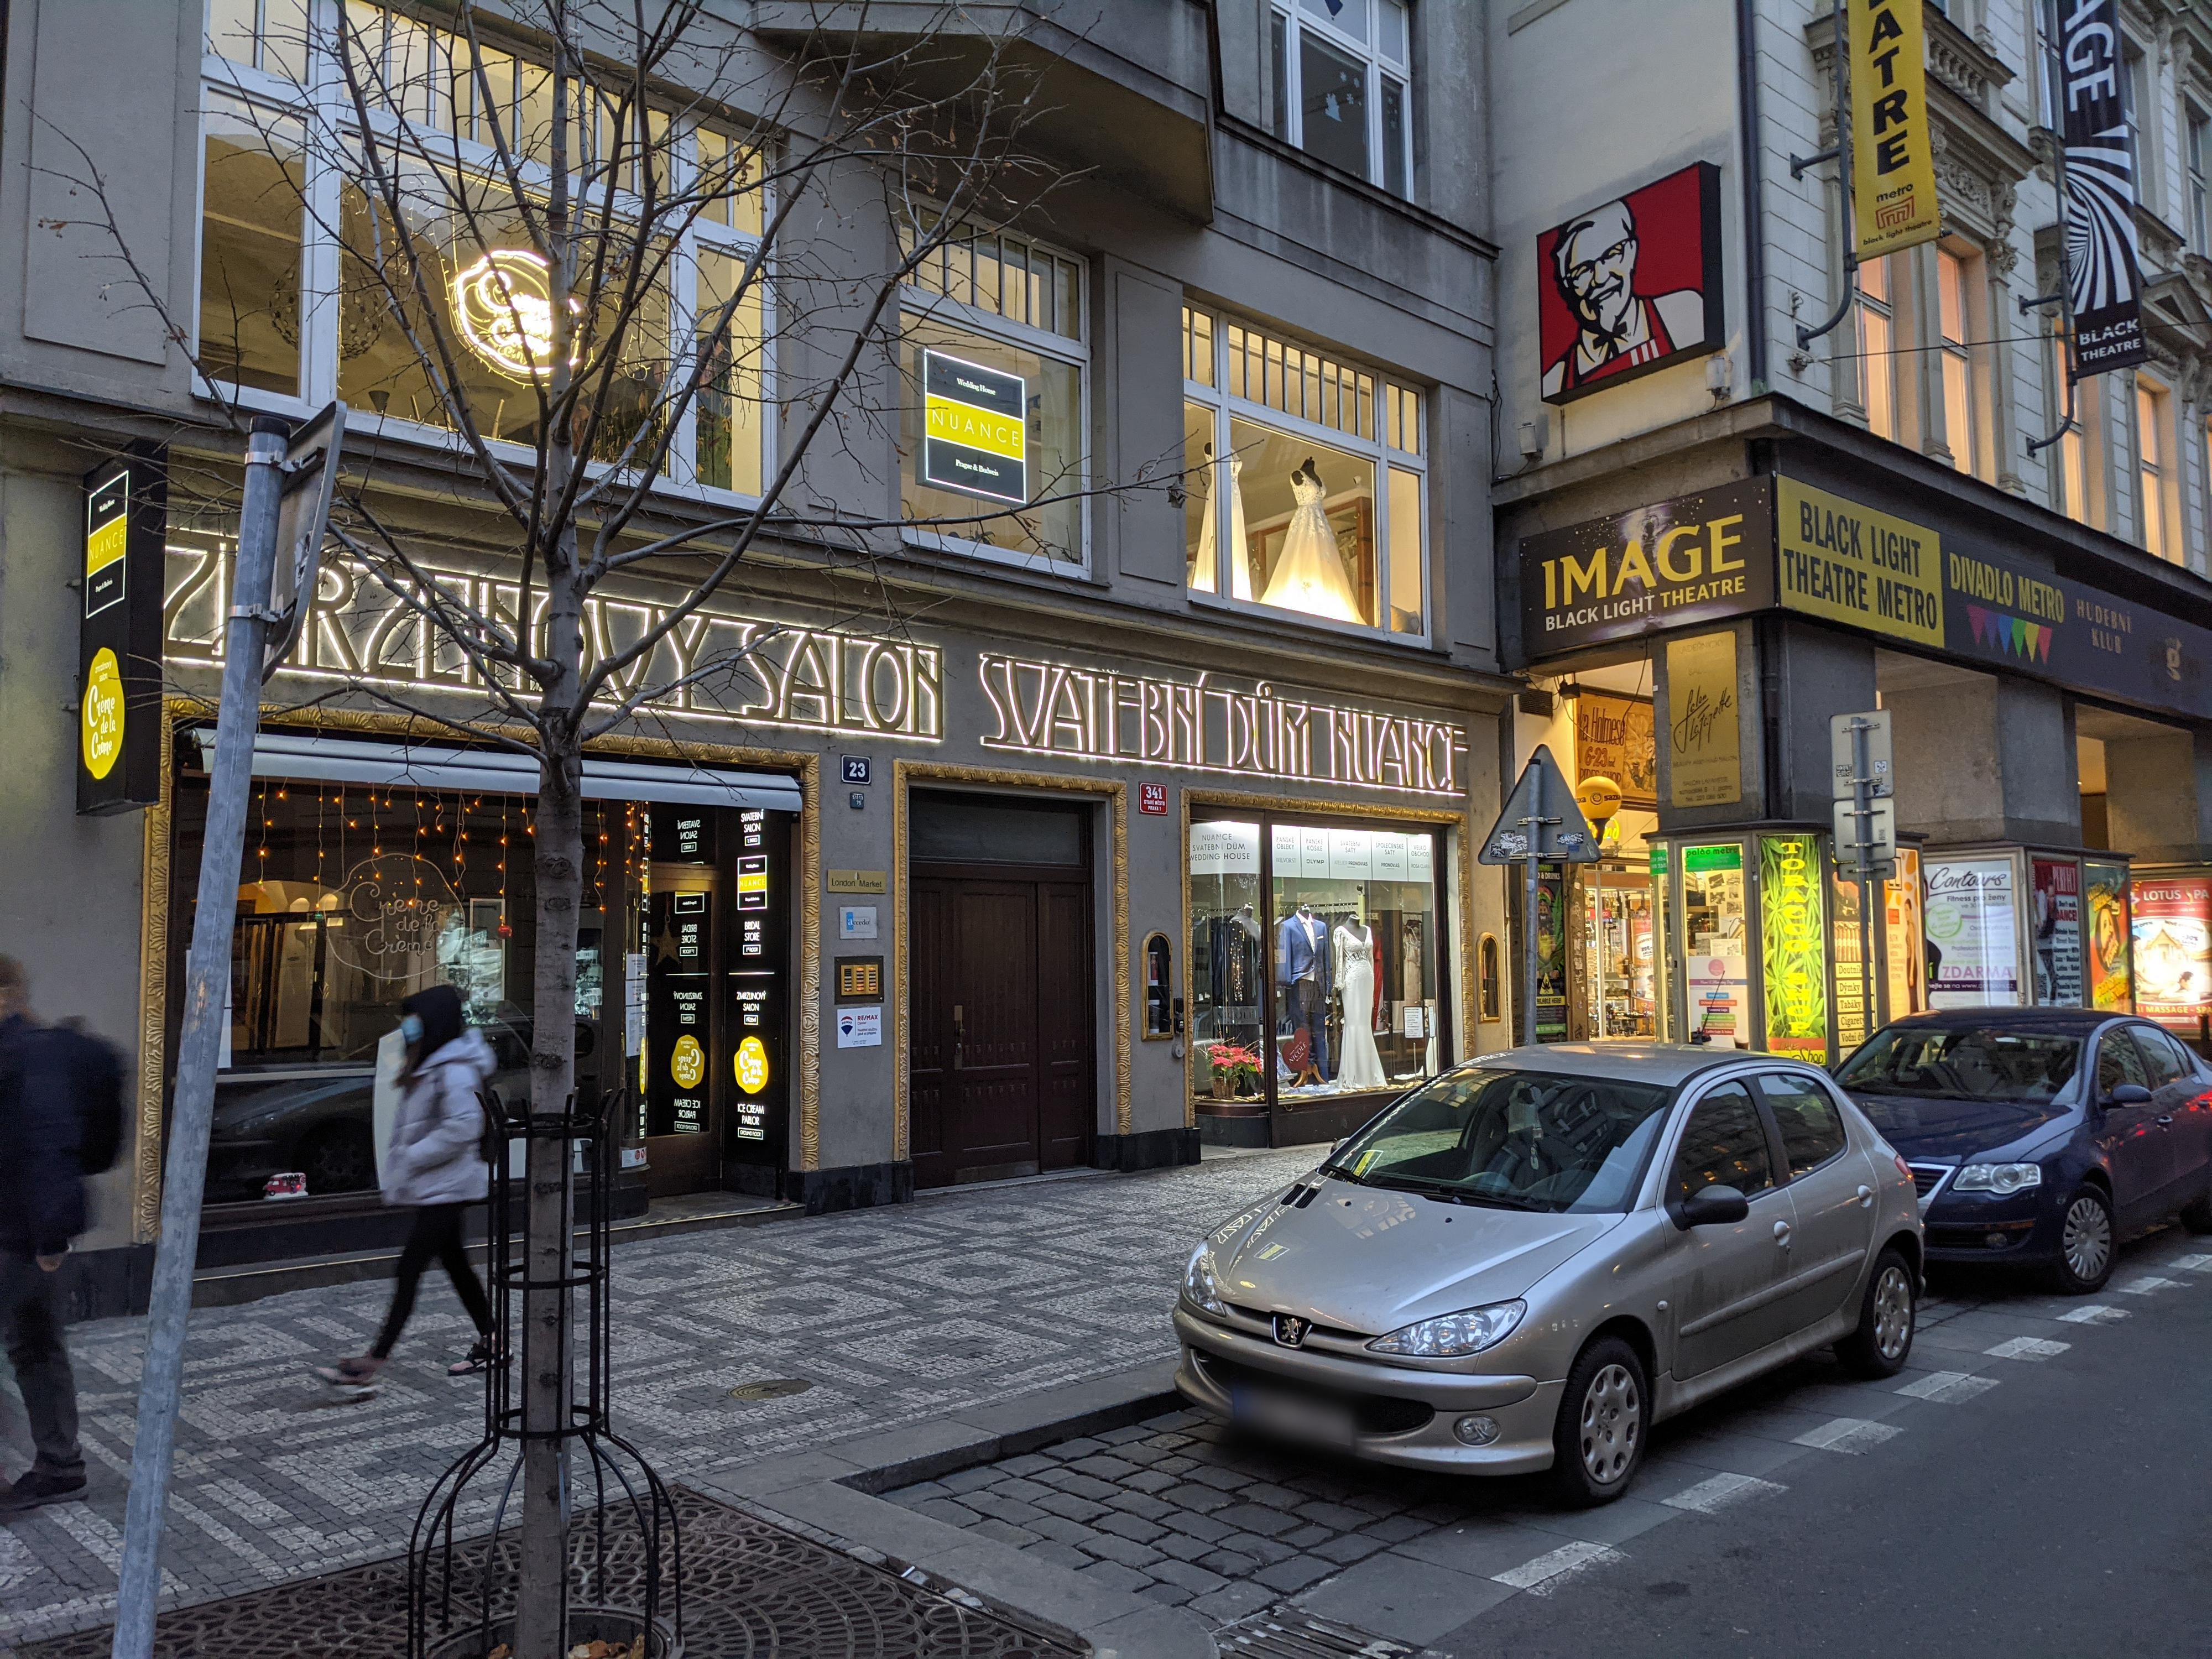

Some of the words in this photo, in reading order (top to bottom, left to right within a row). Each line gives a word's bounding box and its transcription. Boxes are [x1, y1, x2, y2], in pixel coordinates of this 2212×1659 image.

[1869, 0, 1910, 175] ATRE
[1876, 184, 1913, 202] metro
[2079, 319, 2140, 346] BLACK
[2080, 338, 2141, 361] THEATRE
[956, 378, 979, 392] Wedding
[980, 384, 996, 396] House
[932, 409, 1019, 447] NUANCE
[955, 458, 972, 470] Prague
[90, 529, 124, 562] NUANCE
[1801, 500, 1863, 560] BLACK
[1871, 525, 1921, 577] LIGHT
[1541, 514, 1745, 609] IMAGE
[1783, 548, 1869, 612] THEATRE
[1876, 576, 1937, 630] METRO
[1949, 552, 2013, 607] DIVADLO
[2017, 576, 2065, 624] METRO
[1545, 607, 1599, 631] BLACK
[1604, 594, 1655, 620] LIGHT
[1660, 575, 1746, 608] THEATRE
[742, 622, 943, 743] SALON
[88, 685, 115, 727] Crème
[101, 715, 108, 734] de
[109, 712, 116, 733] la
[979, 653, 1210, 766] SVATEBNÍ
[1226, 681, 1314, 777] DŮM
[1328, 708, 1471, 796] NUANCE
[91, 732, 112, 759] Crème
[1584, 746, 1609, 768] 6-23
[849, 761, 865, 778] 23
[1146, 786, 1162, 800] 341
[741, 808, 764, 823] SVATEBNÍ
[743, 822, 761, 833] SALON
[1202, 833, 1232, 841] NUANCE
[1686, 848, 1711, 858] palác
[1712, 846, 1738, 854] metro
[739, 879, 766, 888] NUANCE
[831, 878, 855, 887] London
[859, 879, 881, 888] Market
[1930, 867, 2007, 890] Contours
[1780, 842, 1809, 952] TOBACCO
[2143, 890, 2182, 901] LOTUS
[395, 915, 420, 932] de
[744, 921, 760, 930] BRIDAL
[744, 932, 760, 941] STORE
[1942, 966, 2013, 978] ZDARMA
[1839, 982, 1860, 994] Dýmky
[743, 1003, 759, 1011] SALON
[1840, 1000, 1861, 1011] Tabáky
[1288, 1042, 1307, 1064] NICOLE
[737, 1103, 746, 1113] ICE
[747, 1104, 764, 1115] CREAM
[742, 1115, 760, 1125] PARLOR
